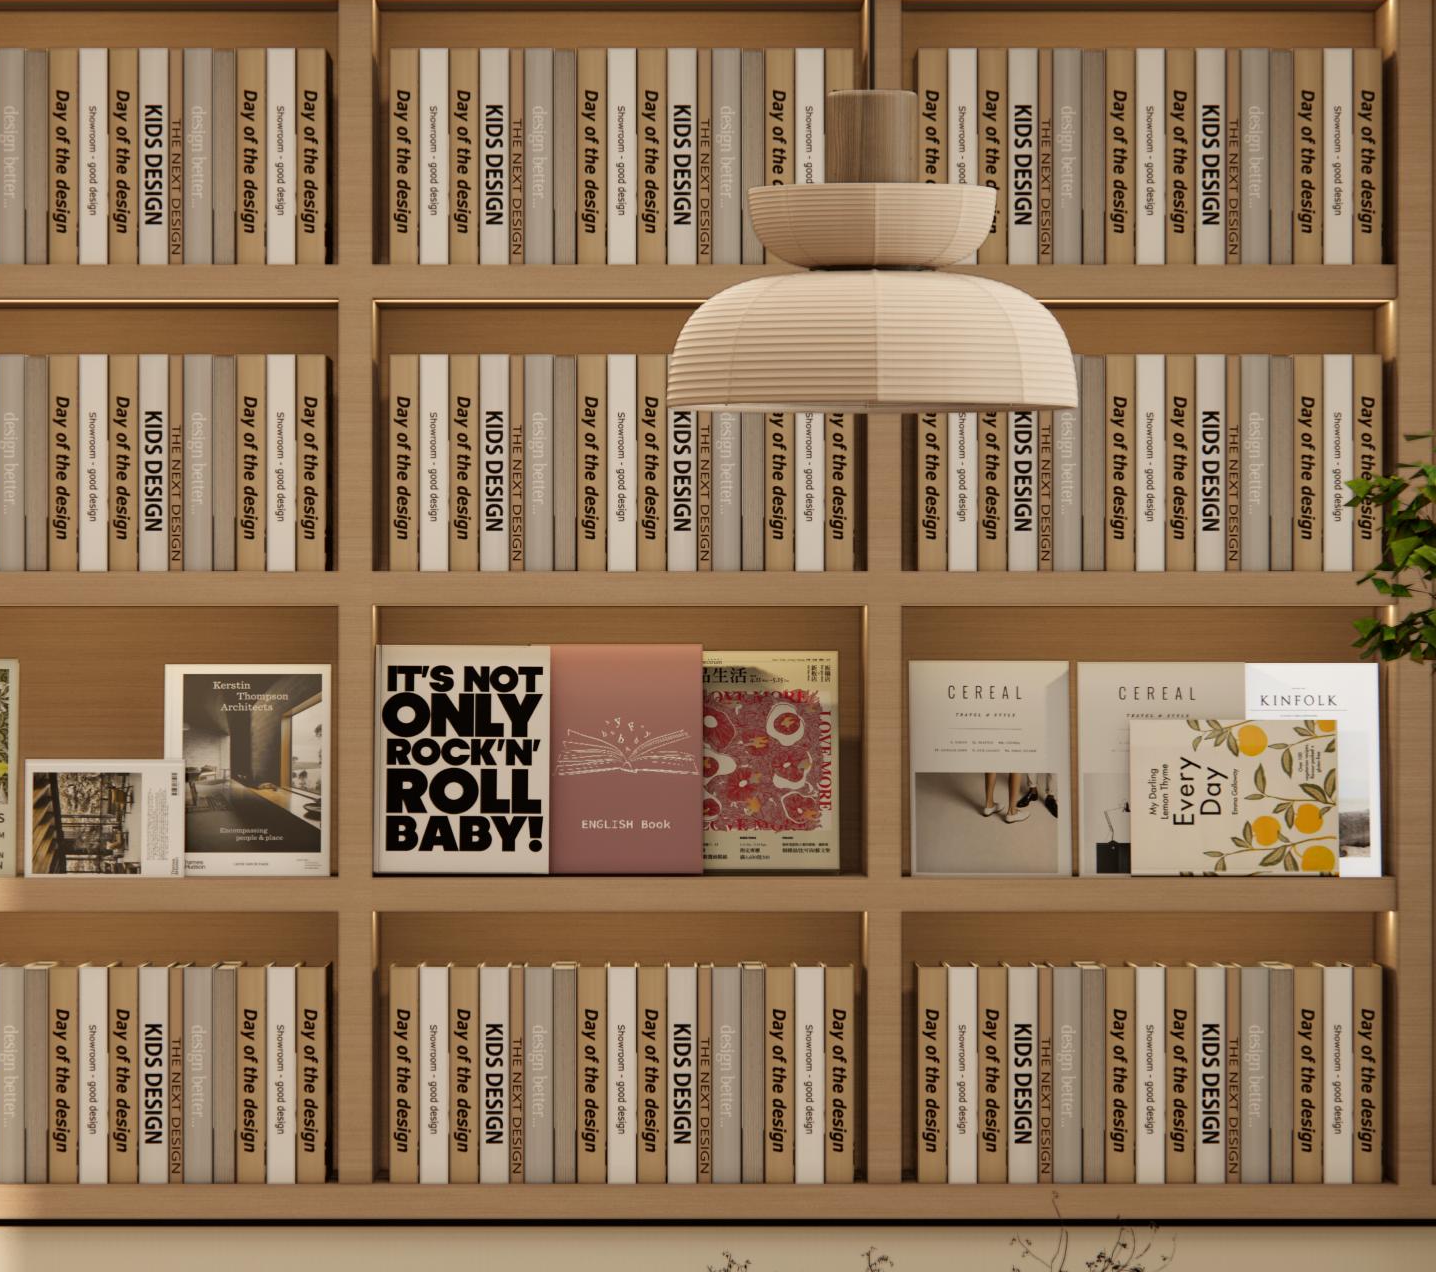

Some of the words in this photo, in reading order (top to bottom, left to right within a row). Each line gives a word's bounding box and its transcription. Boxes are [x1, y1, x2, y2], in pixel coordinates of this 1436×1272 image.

[454, 90, 470, 122] Day
[1358, 90, 1376, 122] Day
[144, 104, 162, 148] KIDS
[456, 125, 472, 144] of
[486, 104, 504, 148] KIDS
[1014, 104, 1032, 148] KIDS
[1360, 125, 1376, 144] of
[456, 148, 472, 174] the
[1360, 148, 1376, 174] the
[144, 154, 162, 226] DESIGN
[486, 154, 504, 226] DESIGN
[1014, 154, 1032, 226] DESIGN
[454, 179, 472, 234] design
[1358, 179, 1376, 234] design
[300, 396, 318, 428] Day
[394, 396, 410, 428] Day
[1110, 396, 1128, 428] Day
[171, 425, 181, 454] THE
[304, 431, 318, 451] of
[396, 431, 412, 451] of
[486, 411, 504, 455] KIDS
[618, 412, 626, 459] Showroom
[1112, 431, 1128, 451] of
[1202, 411, 1220, 455] KIDS
[171, 459, 181, 499] NEXT
[304, 454, 318, 481] the
[396, 454, 412, 481] the
[616, 468, 626, 491] good
[1112, 454, 1128, 481] the
[486, 460, 504, 532] DESIGN
[616, 493, 626, 522] design
[1202, 460, 1220, 532] DESIGN
[300, 485, 318, 540] design
[394, 485, 412, 540] design
[1110, 485, 1128, 540] design
[171, 505, 181, 561] DESIGN
[212, 681, 251, 690] Kerstin
[387, 665, 454, 692] IT'S
[464, 665, 543, 692] NOT
[948, 685, 1022, 700] CEREAL
[1118, 686, 1196, 700] CEREAL
[220, 703, 273, 712] Architects
[236, 692, 289, 702] Thompson
[1260, 694, 1338, 706] KINFOLK
[381, 692, 543, 738] ONLY
[386, 738, 540, 766] ROCK'N'
[385, 768, 542, 814] ROLL
[819, 761, 831, 811] MORE
[1148, 768, 1159, 800] Darling
[1160, 764, 1171, 790] Thyme
[1173, 756, 1202, 826] Every
[1200, 767, 1228, 816] Day
[1149, 801, 1158, 816] My
[385, 815, 543, 852] BABY!
[581, 820, 634, 830] ENGLISH
[641, 820, 671, 830] Book
[240, 1009, 258, 1041] Day
[144, 1024, 162, 1068] KIDS
[244, 1044, 258, 1064] of
[486, 1024, 504, 1068] KIDS
[512, 1038, 522, 1067] THE
[1014, 1024, 1032, 1068] KIDS
[1334, 1025, 1342, 1072] Showroom
[244, 1067, 258, 1094] the
[512, 1072, 522, 1112] NEXT
[1332, 1081, 1342, 1104] good
[144, 1073, 162, 1145] DESIGN
[486, 1073, 504, 1145] DESIGN
[1014, 1073, 1032, 1145] DESIGN
[1332, 1106, 1342, 1135] design
[240, 1098, 258, 1153] design
[512, 1118, 522, 1174] DESIGN
